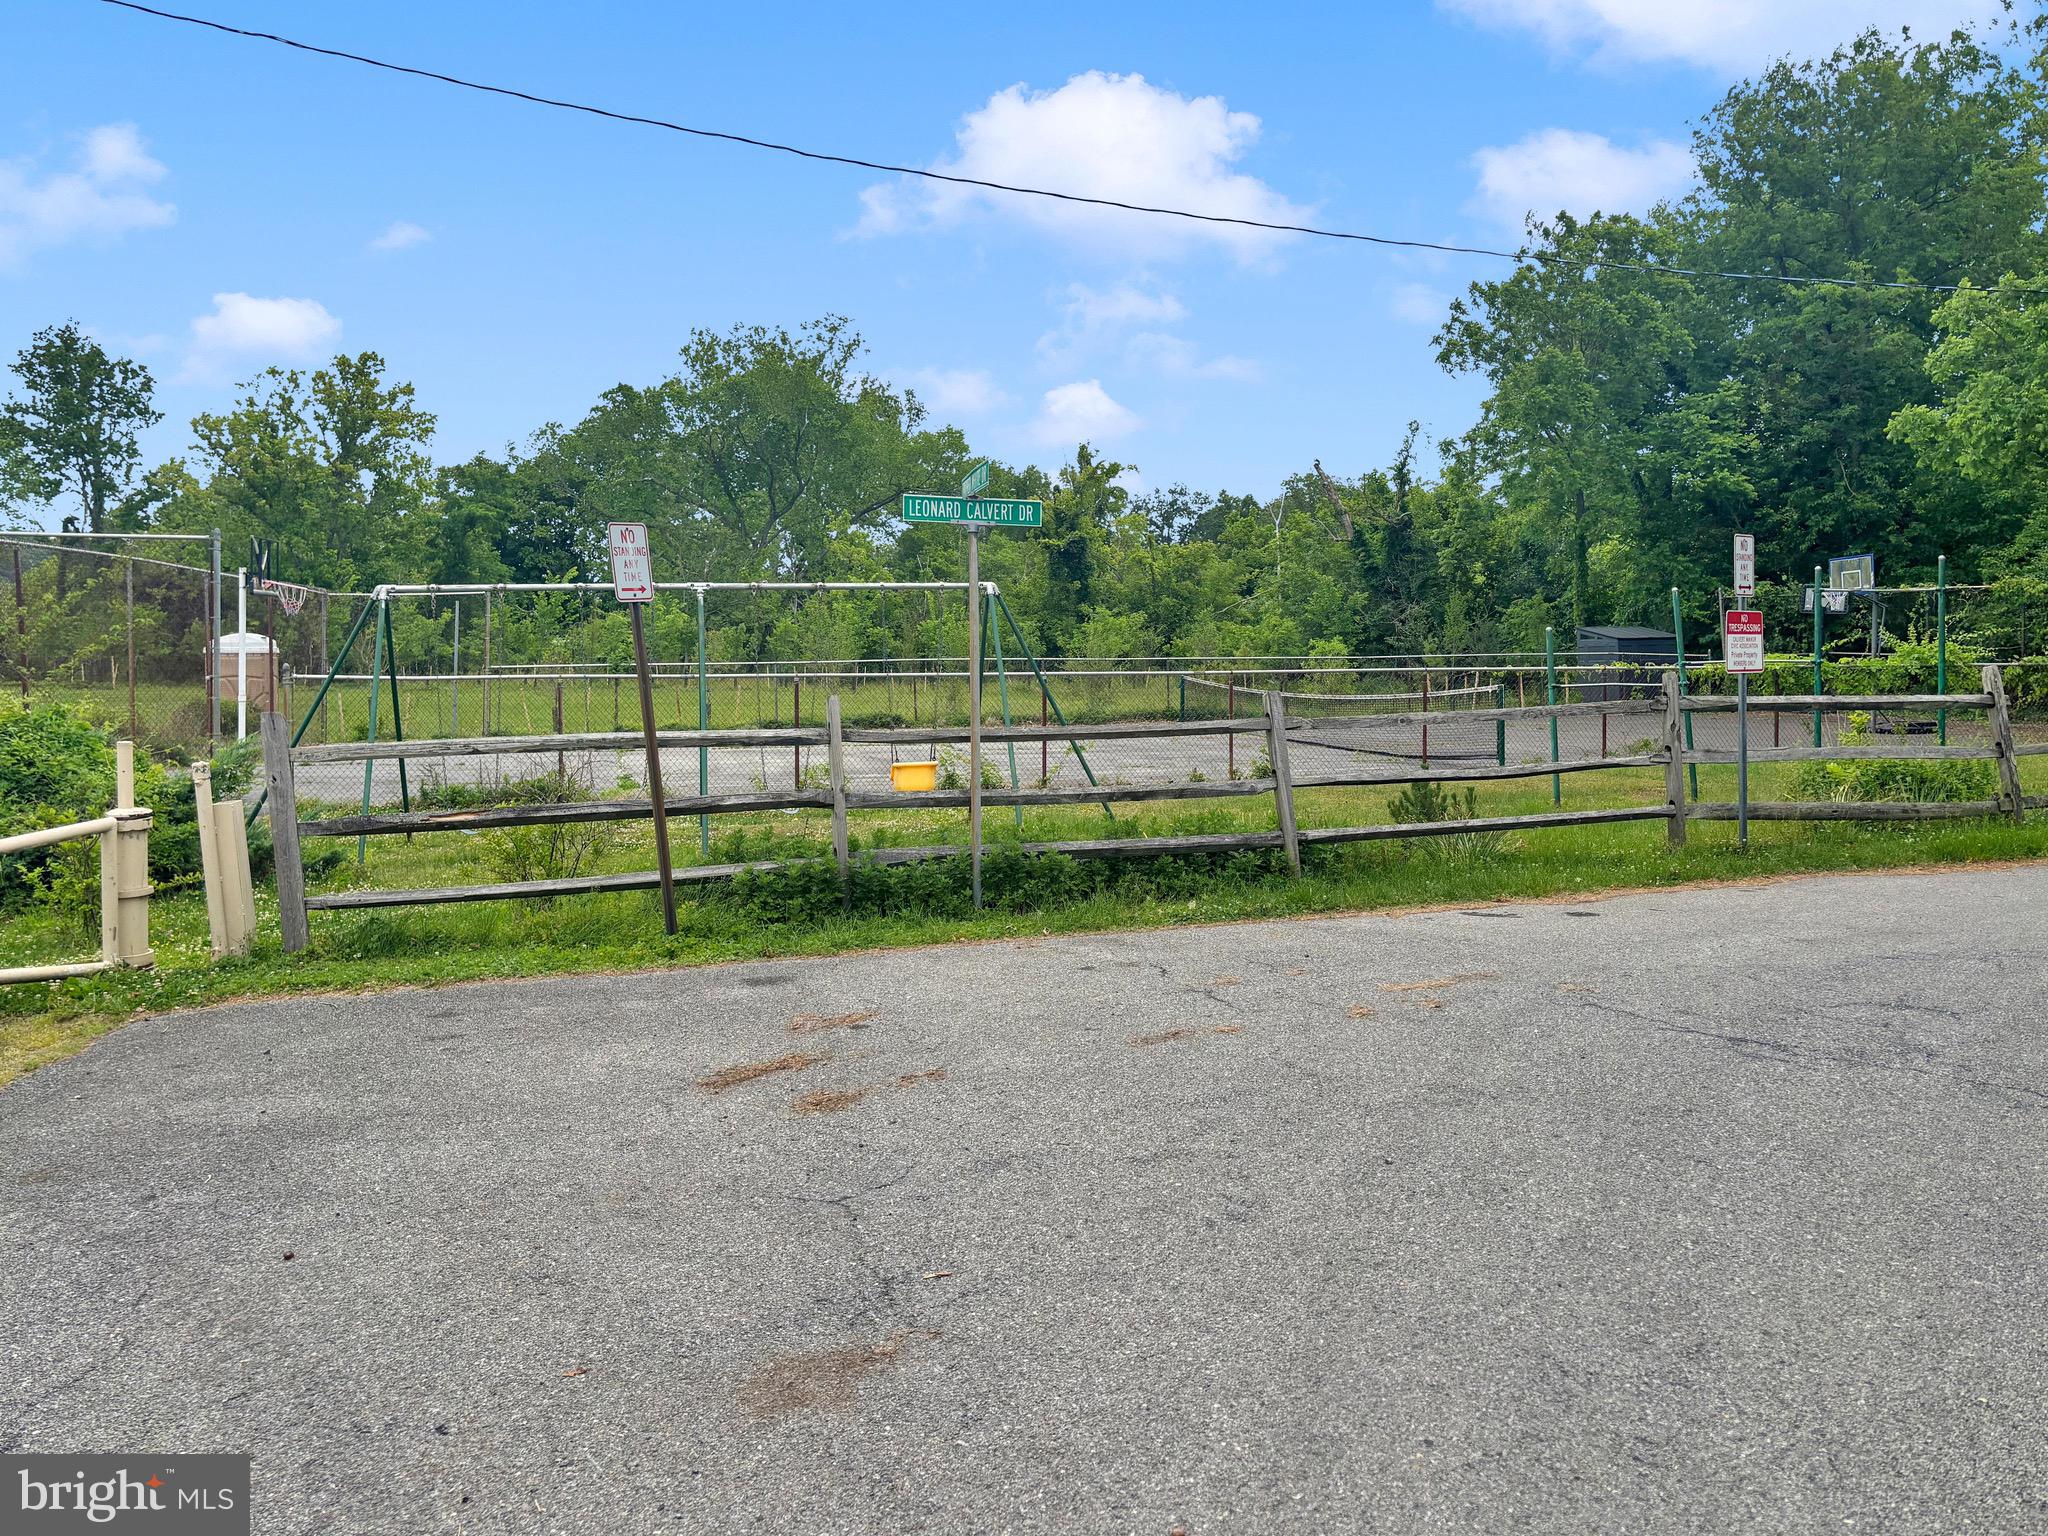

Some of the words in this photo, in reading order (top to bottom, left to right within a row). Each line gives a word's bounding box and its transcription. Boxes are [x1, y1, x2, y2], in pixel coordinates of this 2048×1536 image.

[909, 499, 960, 519] LEONARD
[966, 502, 1013, 521] CALVERT
[1019, 505, 1033, 521] DR
[620, 528, 635, 544] NO
[1740, 539, 1748, 551] NO
[624, 560, 638, 569] ANY
[623, 572, 642, 582] TIME
[1740, 573, 1749, 581] TIME
[1740, 614, 1748, 623] NO
[1729, 623, 1760, 632] TRESPASSING
[1744, 651, 1757, 660] Property
